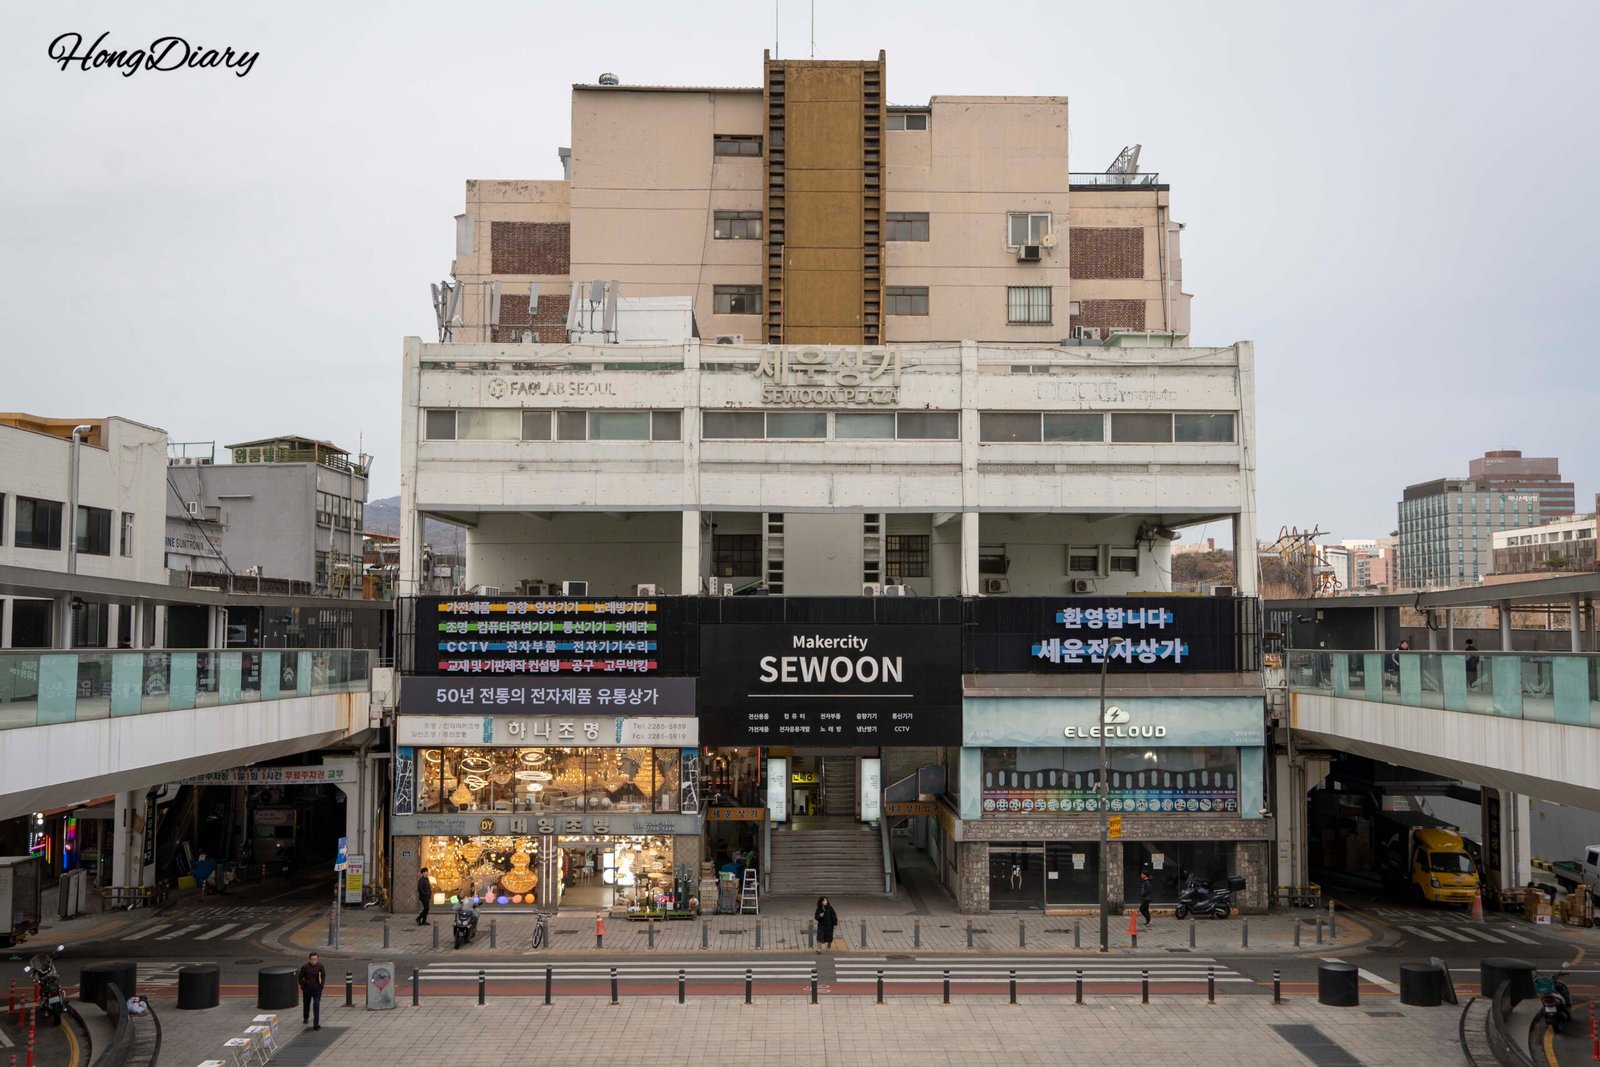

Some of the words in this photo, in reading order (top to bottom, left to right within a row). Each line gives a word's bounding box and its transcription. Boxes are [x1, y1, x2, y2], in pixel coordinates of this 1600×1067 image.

[752, 346, 900, 388] 세운상가
[569, 381, 617, 396] SEOUL
[761, 388, 838, 404] SEWOON
[842, 388, 900, 404] PLAZA
[447, 602, 490, 615] 가전제품
[594, 602, 648, 615] 노래방기기
[1063, 607, 1168, 629] 환영합니다
[446, 621, 468, 634] 조명
[477, 621, 553, 634] 컴퓨터주변기기
[563, 621, 606, 634] 통신기기
[616, 621, 648, 634] 카메라
[447, 641, 489, 653] CCTV
[506, 641, 556, 653] 전자부품
[573, 641, 648, 653] 전자기기수리
[793, 635, 868, 651] Makercity
[1037, 637, 1184, 664] 세운전자상가
[472, 660, 482, 672] 및
[484, 660, 526, 672] 기판제작
[528, 660, 560, 672] 컨설팅
[572, 660, 594, 672] 공구
[604, 660, 648, 672] 고무박킹
[759, 655, 903, 683] SEWOON
[436, 688, 474, 705] 50년
[479, 688, 525, 705] 전통의
[530, 688, 592, 705] 전자제품
[597, 688, 659, 705] 유통상가
[508, 721, 600, 741] 하나조명
[1063, 725, 1167, 738] ELECLOUD
[285, 769, 325, 780] 무료주차권
[712, 809, 759, 819] 세운상가
[481, 821, 493, 830] DY
[510, 817, 609, 834] 대영조명
